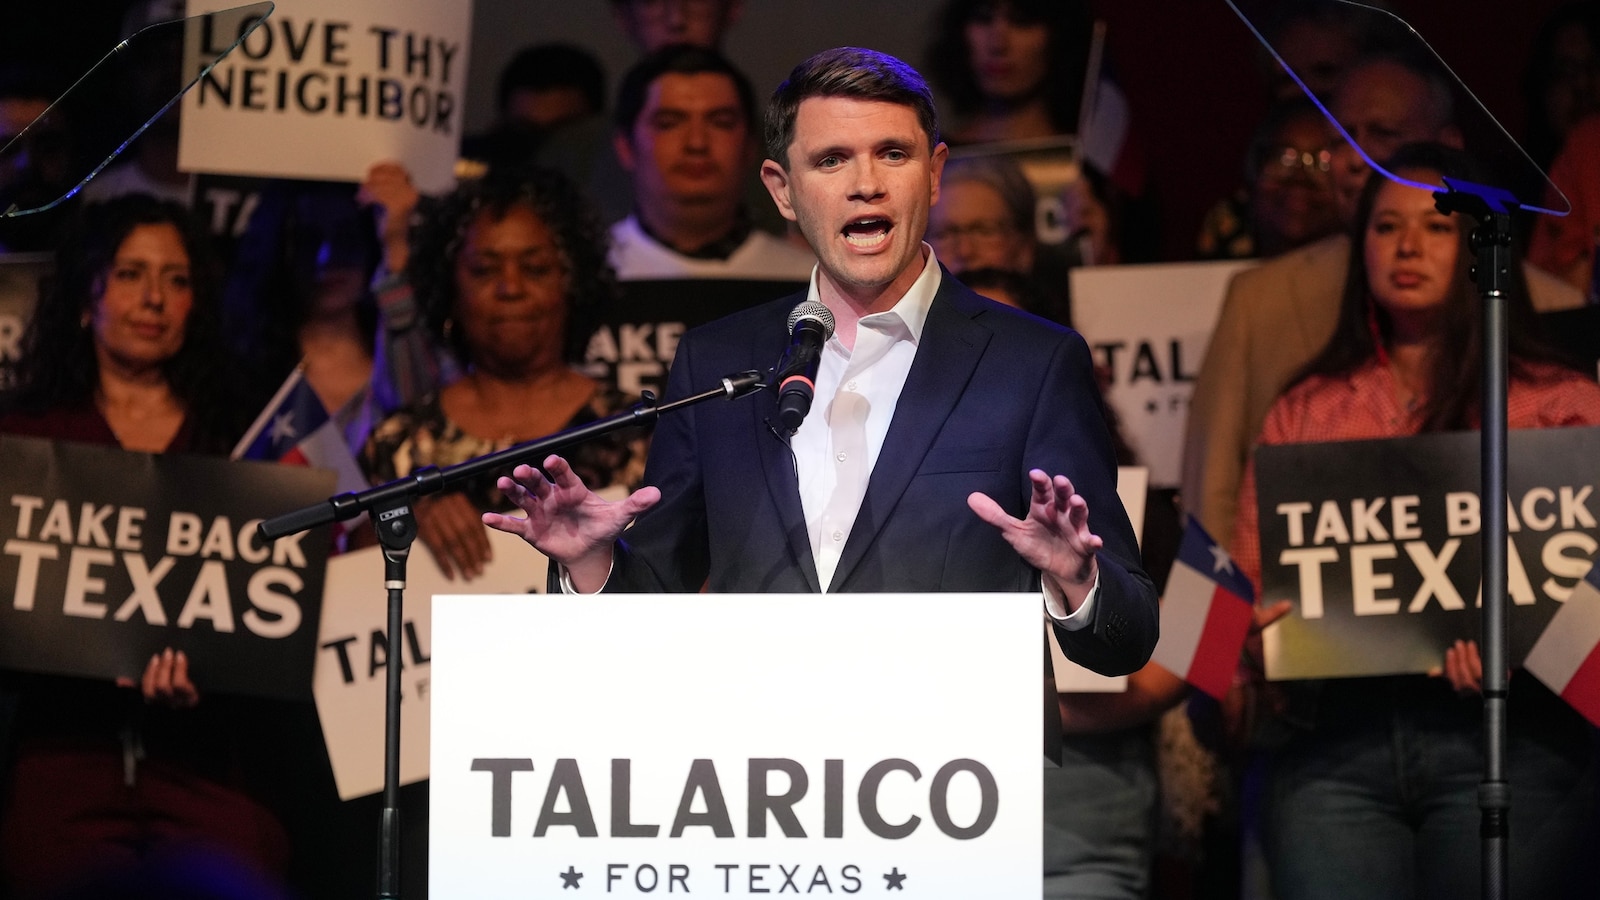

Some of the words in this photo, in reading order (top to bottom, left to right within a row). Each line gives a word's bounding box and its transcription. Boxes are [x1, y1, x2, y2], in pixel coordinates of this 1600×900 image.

[202, 13, 350, 67] LOVE
[368, 24, 459, 84] THY
[198, 64, 456, 136] NEIGHBOR
[10, 494, 147, 550] TAKE
[165, 511, 311, 569] BACK
[1276, 494, 1423, 547] TAKE
[3, 539, 305, 639] TEXAS
[470, 758, 999, 840] TALARICO
[606, 863, 691, 893] FOR
[714, 863, 863, 893] TEXAS
